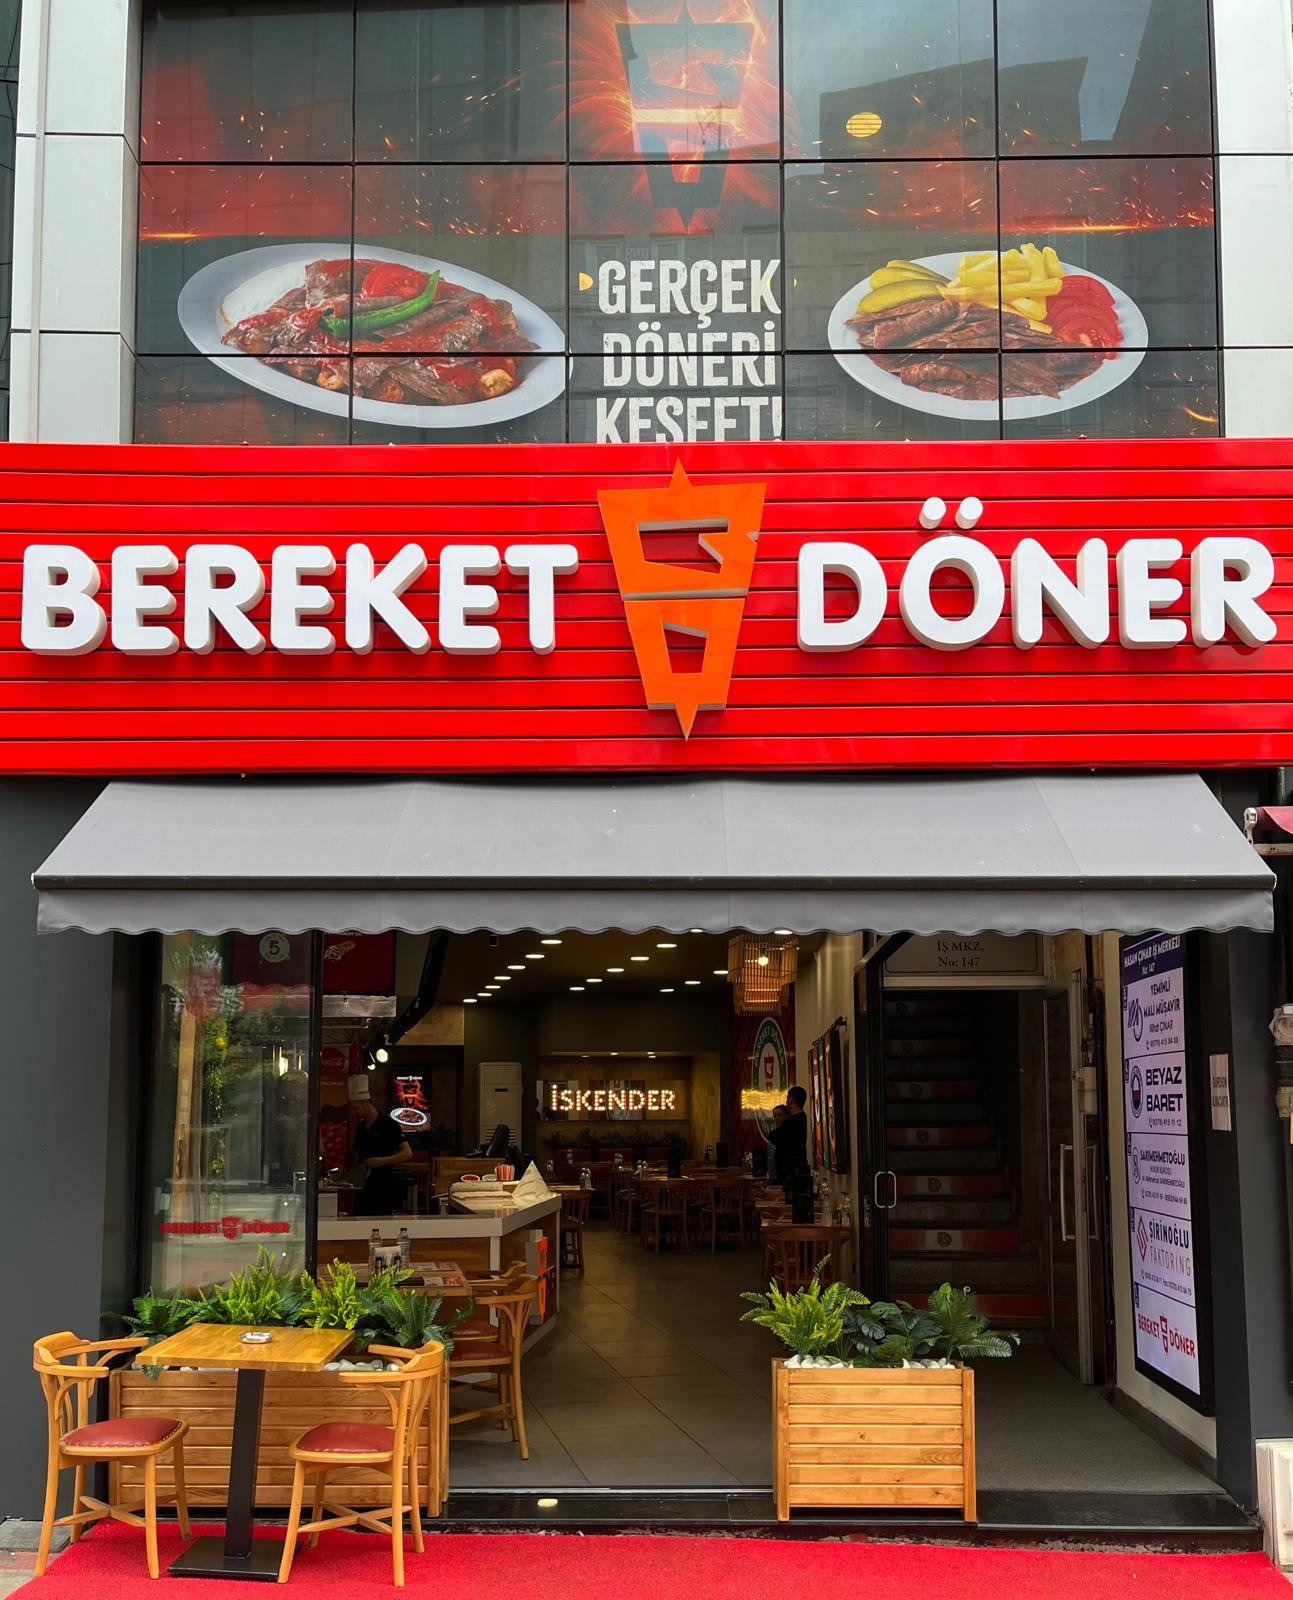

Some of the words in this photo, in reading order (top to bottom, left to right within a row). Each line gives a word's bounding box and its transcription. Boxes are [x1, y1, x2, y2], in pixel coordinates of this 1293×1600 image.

[598, 259, 782, 329] GERÇEK
[603, 320, 776, 387] DÖNERİ
[20, 543, 579, 656] BEREKET
[798, 495, 1278, 653] DÖNER
[269, 940, 280, 955] 5
[937, 939, 949, 954] İŞ
[951, 940, 984, 952] MKZ.
[937, 957, 959, 968] No:
[961, 957, 981, 968] 147
[1146, 1066, 1183, 1086] BEYAZ
[551, 1084, 676, 1111] İSKENDER
[1146, 1093, 1184, 1112] BARET
[1138, 1313, 1160, 1340] BEREKET
[1169, 1327, 1196, 1358] DÖNER
